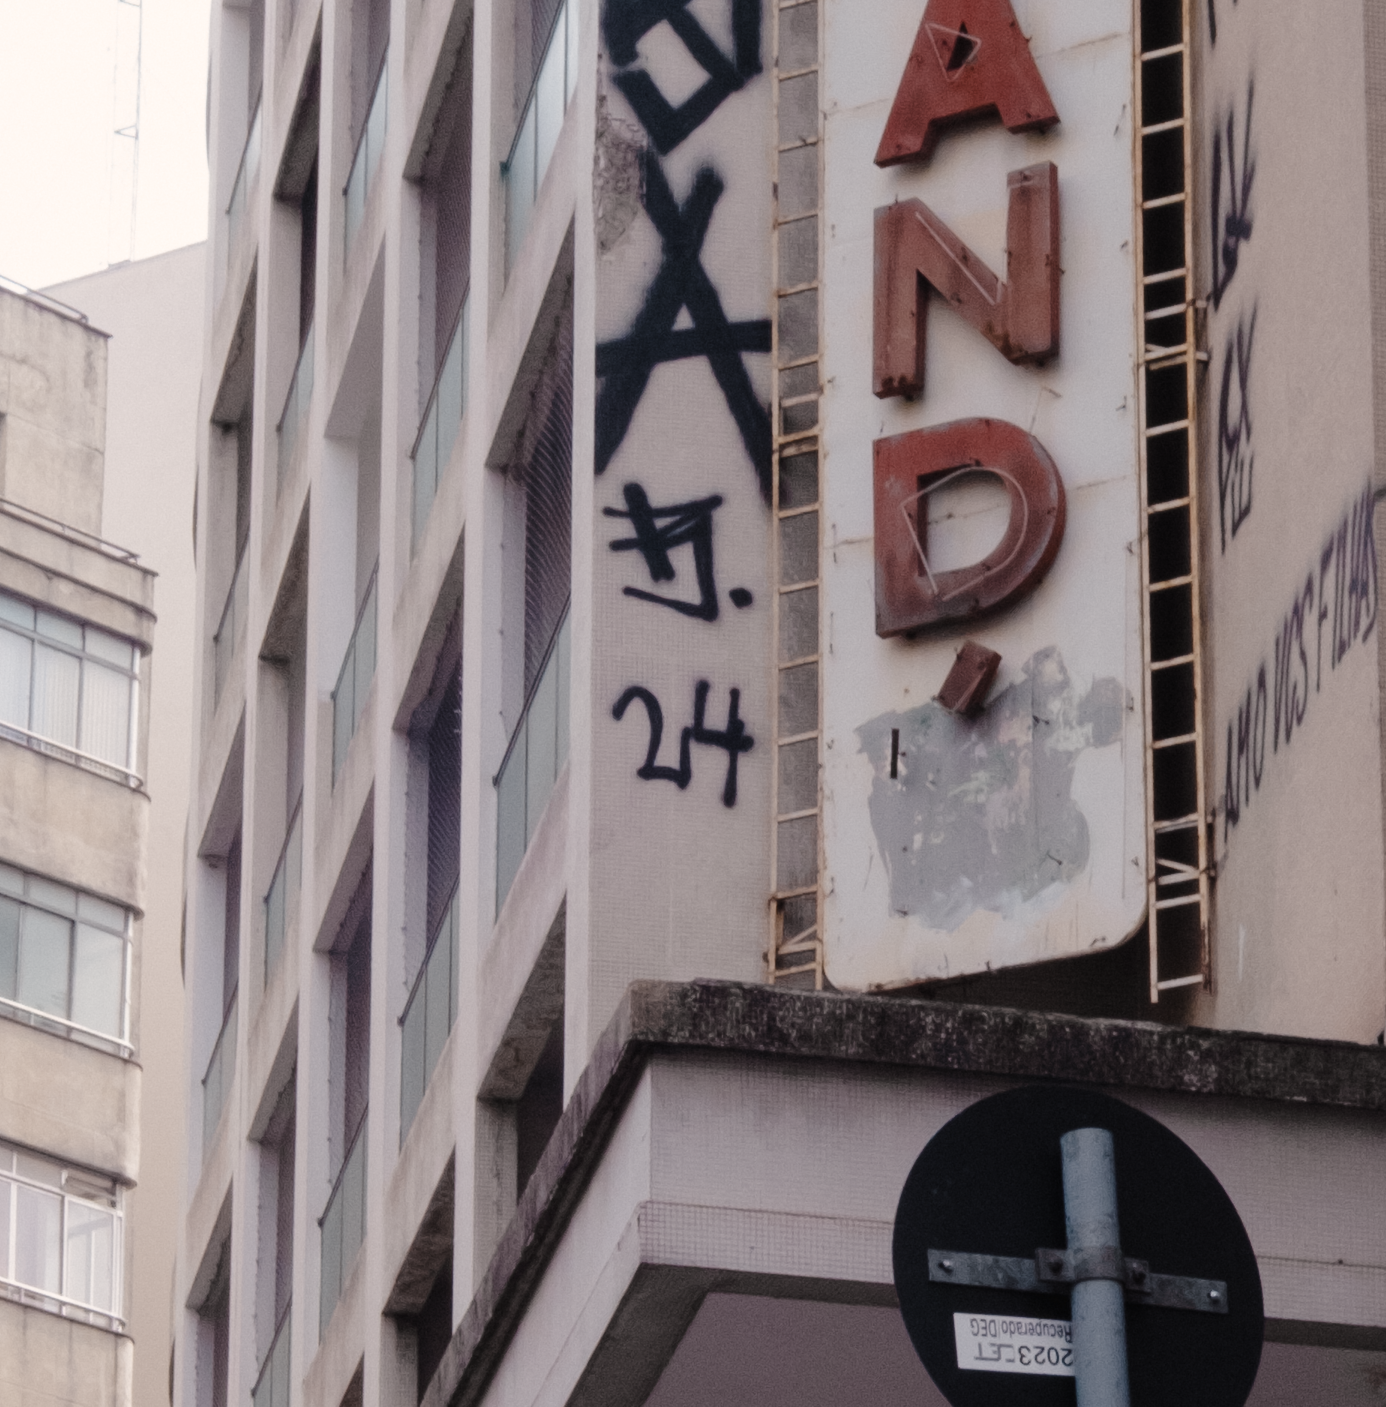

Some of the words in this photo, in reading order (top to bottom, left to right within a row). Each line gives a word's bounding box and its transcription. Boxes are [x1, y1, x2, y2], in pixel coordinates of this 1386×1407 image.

[613, 680, 754, 807] 24
[1001, 1320, 1073, 1343] Recuperado
[1018, 1345, 1073, 1366] 2023
